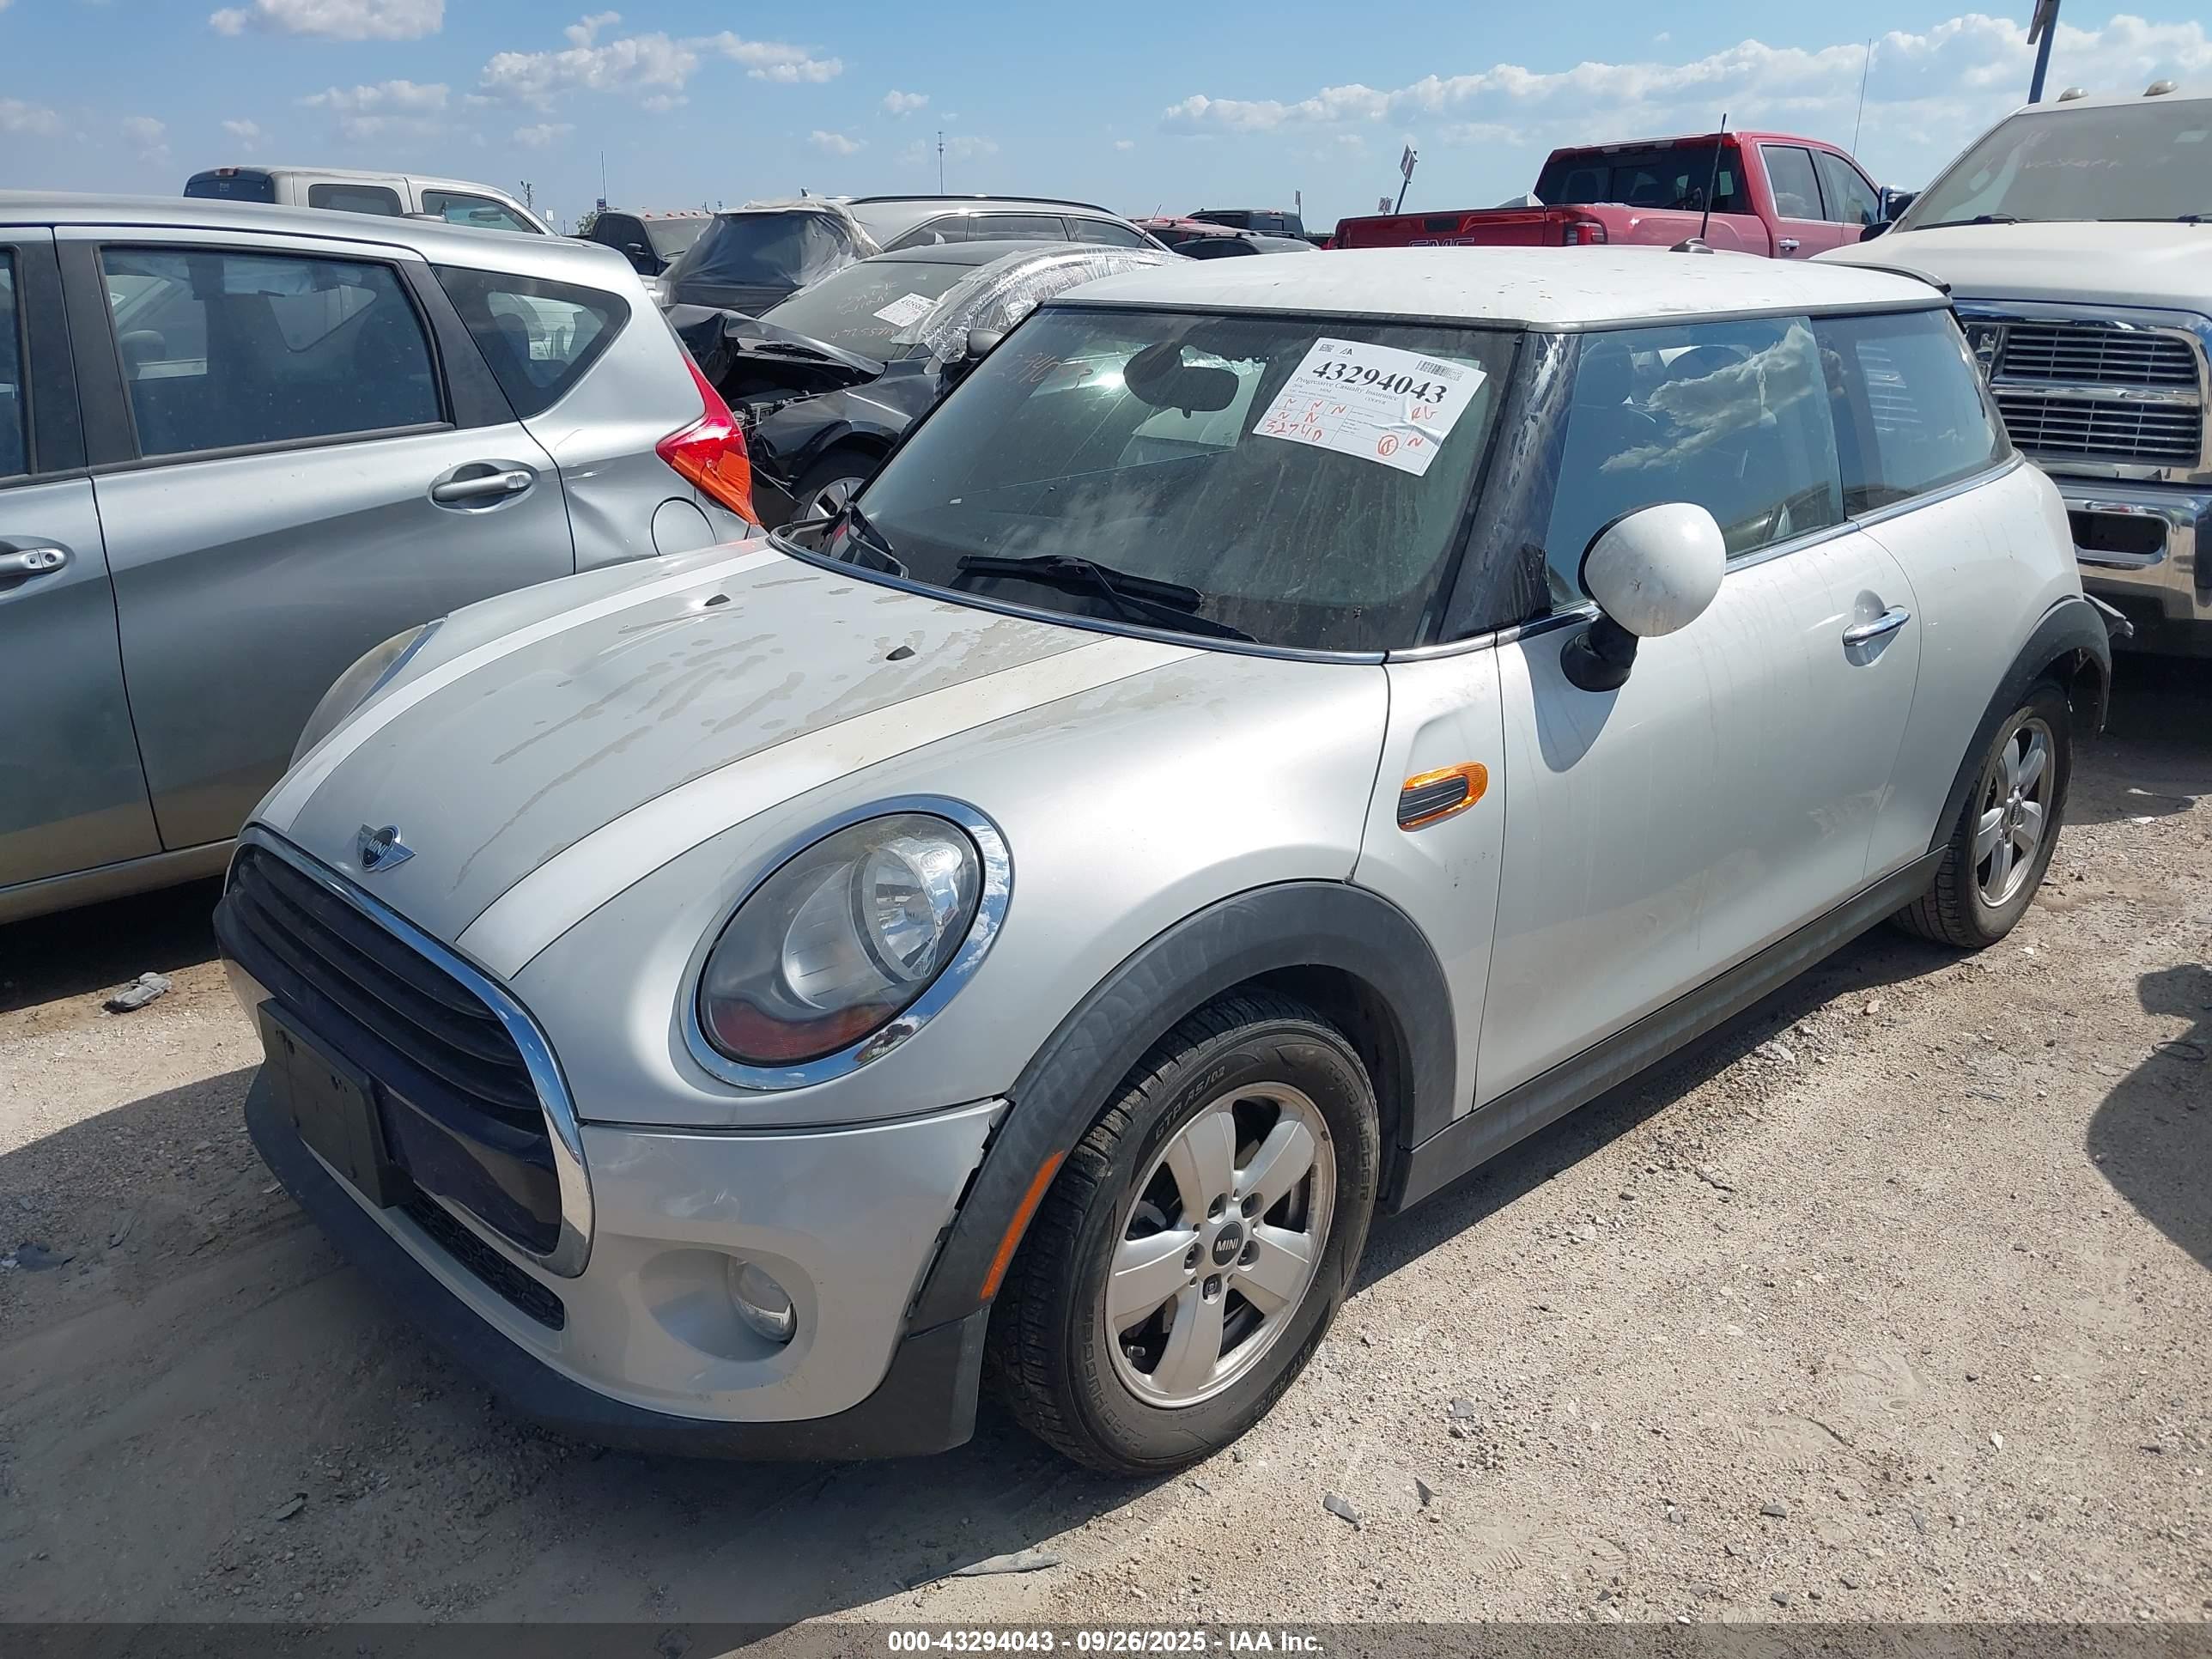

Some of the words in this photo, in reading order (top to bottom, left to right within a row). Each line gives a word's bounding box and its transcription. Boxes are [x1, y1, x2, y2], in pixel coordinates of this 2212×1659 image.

[1296, 376, 1334, 387] Progressive
[1334, 382, 1363, 394] Casualty
[1365, 389, 1400, 402] Insurance
[1312, 361, 1448, 404] 43294043
[367, 837, 389, 856] MINI
[1216, 1237, 1239, 1253] MINI
